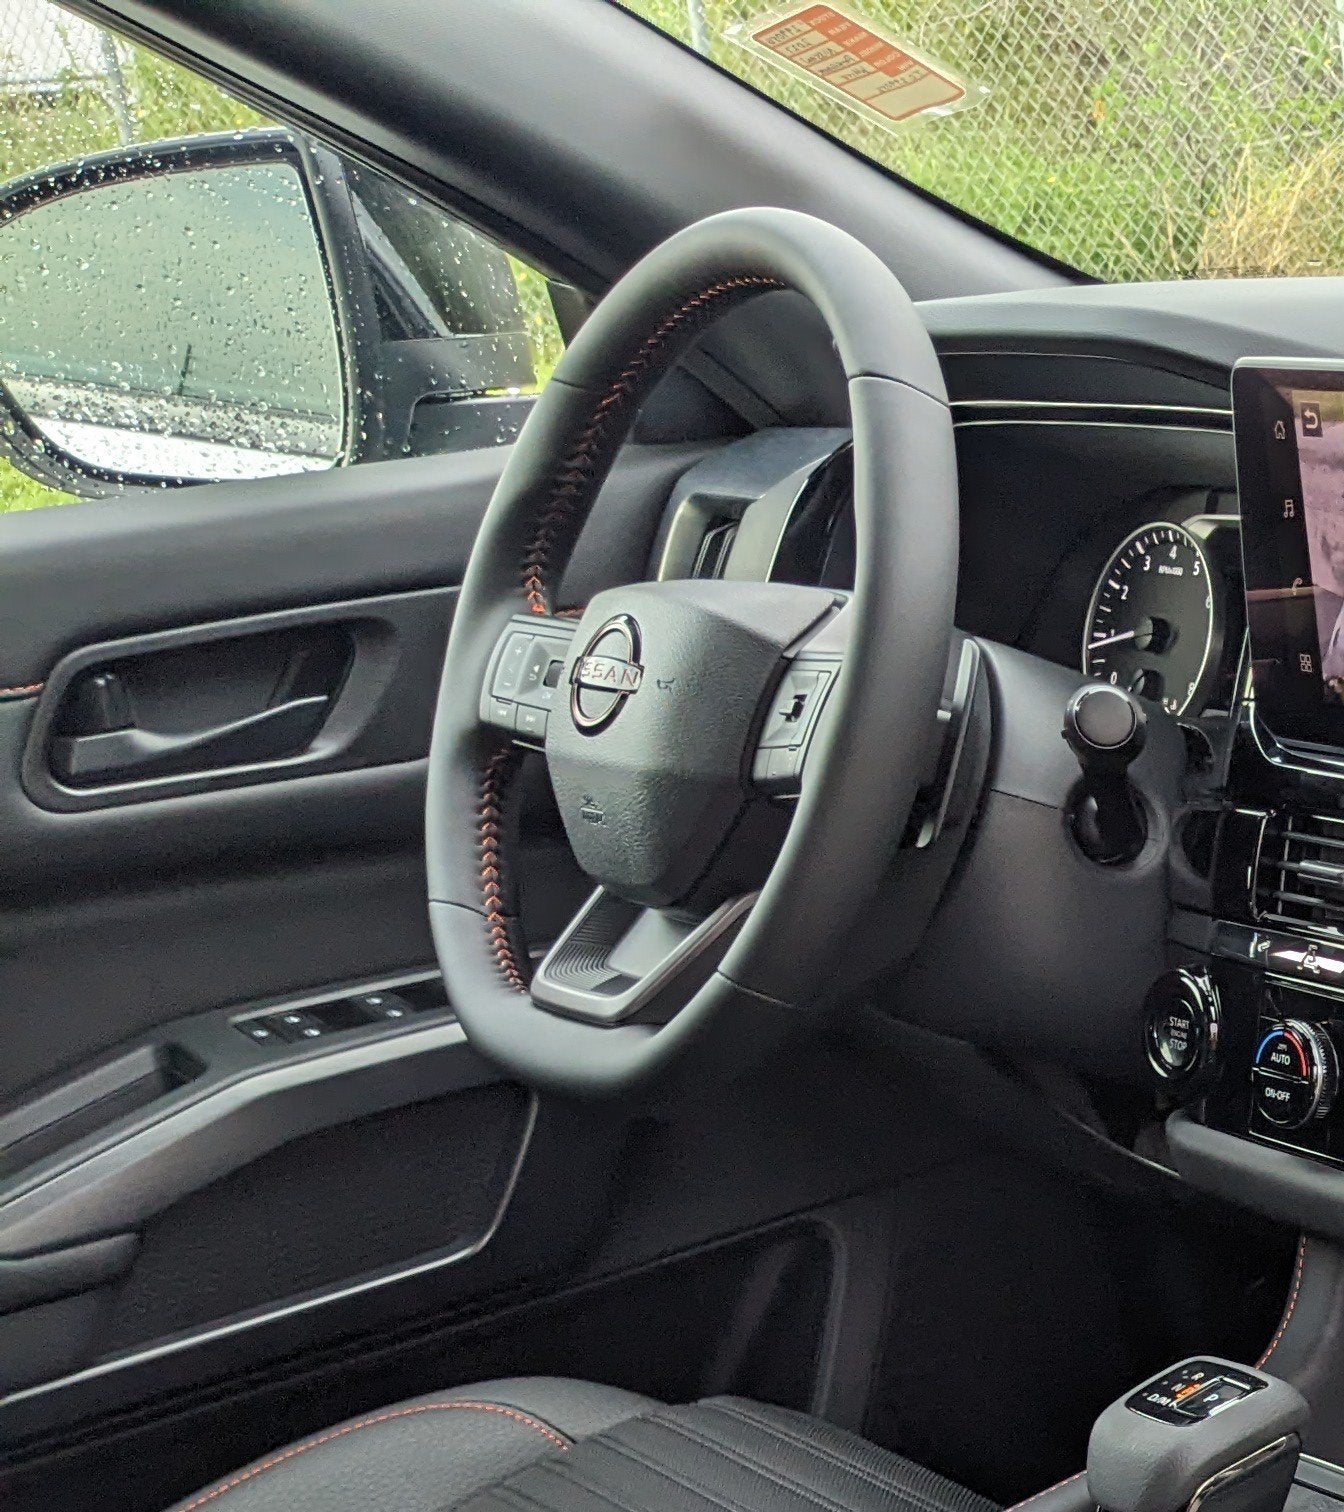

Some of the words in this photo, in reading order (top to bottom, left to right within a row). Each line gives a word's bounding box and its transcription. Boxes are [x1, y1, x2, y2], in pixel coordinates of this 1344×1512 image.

[1143, 555, 1151, 571] 3
[1192, 560, 1201, 576] 5
[1120, 585, 1129, 600] 2
[580, 659, 640, 688] SSAN
[1110, 671, 1118, 685] 0
[1169, 1016, 1190, 1030] START
[1168, 1038, 1188, 1051] STOP
[1270, 1051, 1291, 1066] AUTO
[1202, 1393, 1220, 1403] P
